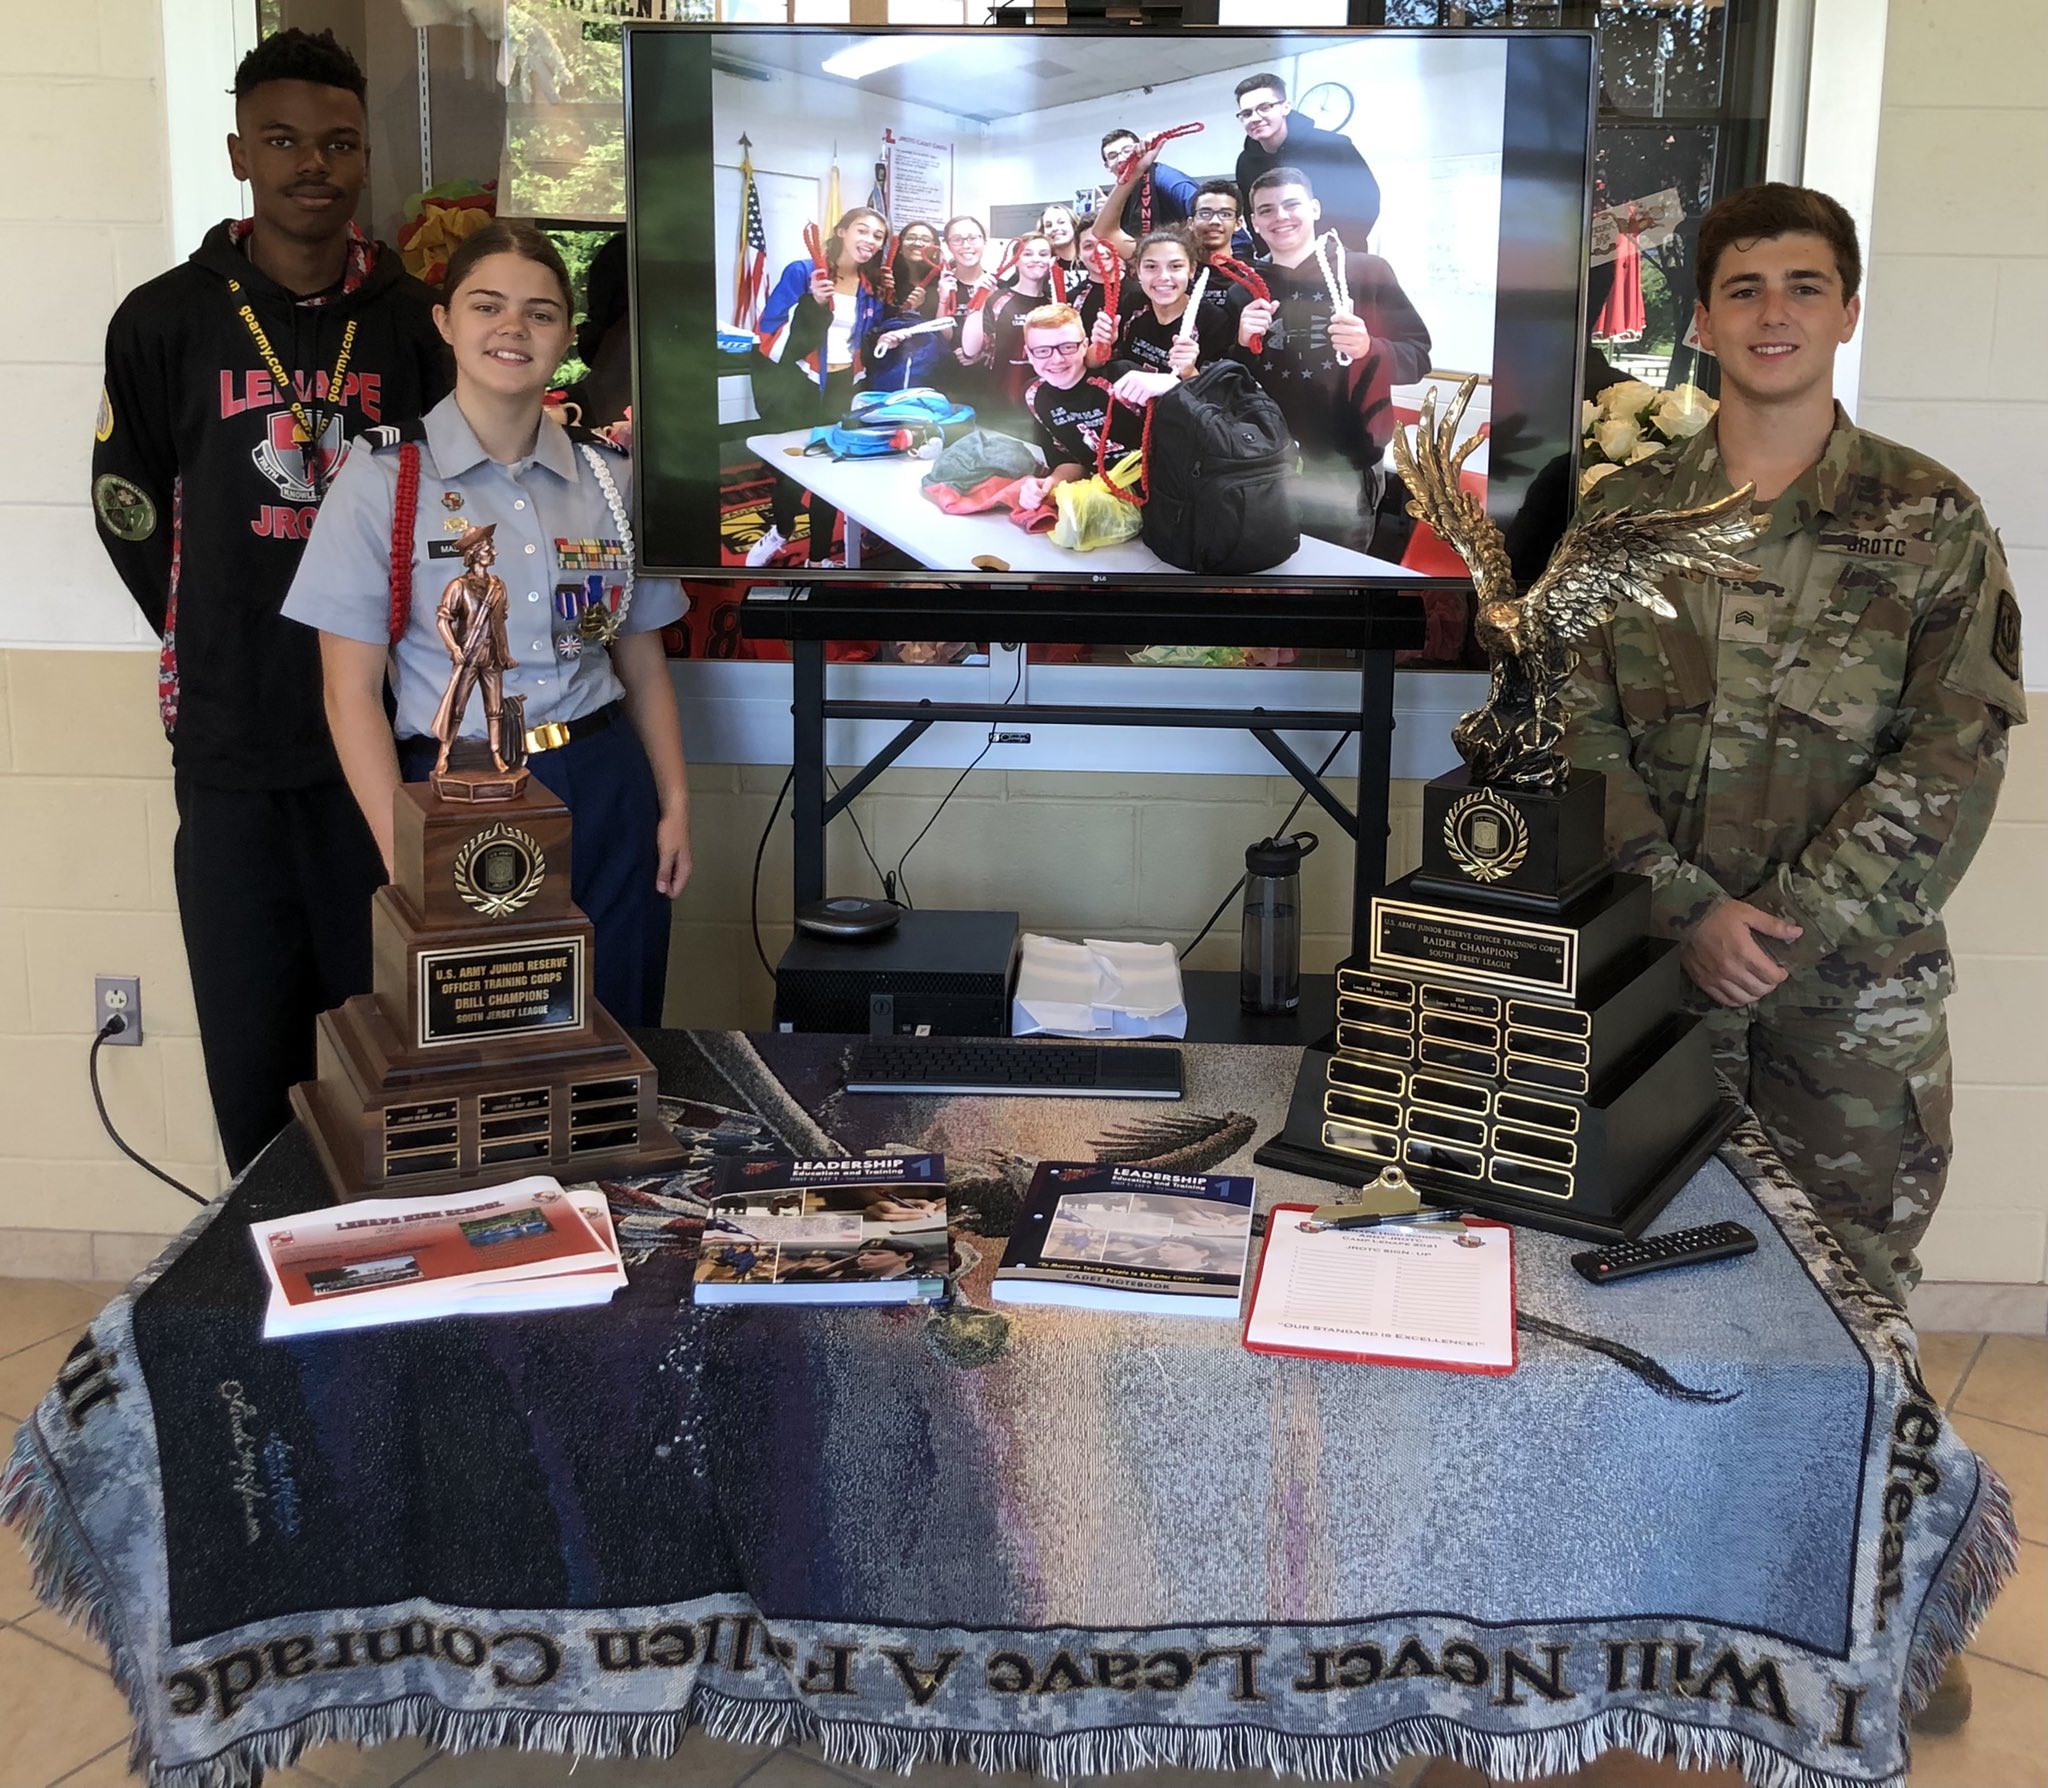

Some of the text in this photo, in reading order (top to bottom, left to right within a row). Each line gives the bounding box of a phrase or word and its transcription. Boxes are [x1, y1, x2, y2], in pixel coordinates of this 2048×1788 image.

[1141, 173, 1152, 237] ENAPE
[239, 304, 290, 387] goarmy.com
[328, 320, 358, 403] goarmy.com
[257, 456, 279, 480] TRUTH
[283, 488, 316, 500] KNOWL
[250, 504, 319, 540] JRO
[1384, 918, 1562, 954] U.S. ARMY JUNIOR RESERVE OFFICER TRAINING CORPS
[1423, 936, 1519, 960] RAIDER CHAMPIONS
[436, 957, 568, 980] U.S. ARMY JUNIOR RESERVE
[1429, 949, 1511, 970] SOUTH JERSEY LEAGUE
[442, 972, 562, 994] OFFICER TRAINING CORPS
[455, 989, 550, 1010] DRILL CHAMPIONS
[456, 1005, 548, 1024] SOUTH JERSEY LEAGUE
[793, 1159, 904, 1170] LEADERSHIP
[865, 1168, 904, 1176] Training
[1113, 1168, 1207, 1184] LEADERSHIP
[1111, 1176, 1152, 1186] Education
[1173, 1183, 1206, 1191] Training
[1065, 1273, 1171, 1290] CADET NOTEBOOK
[1313, 1326, 1380, 1336] STANDARD
[164, 1620, 562, 1718] Comrade
[878, 1646, 965, 1705] A
[985, 1648, 1267, 1701] Leave
[1294, 1636, 1574, 1706] Never
[1602, 1638, 1796, 1728] Will
[1825, 1683, 1866, 1749] I
